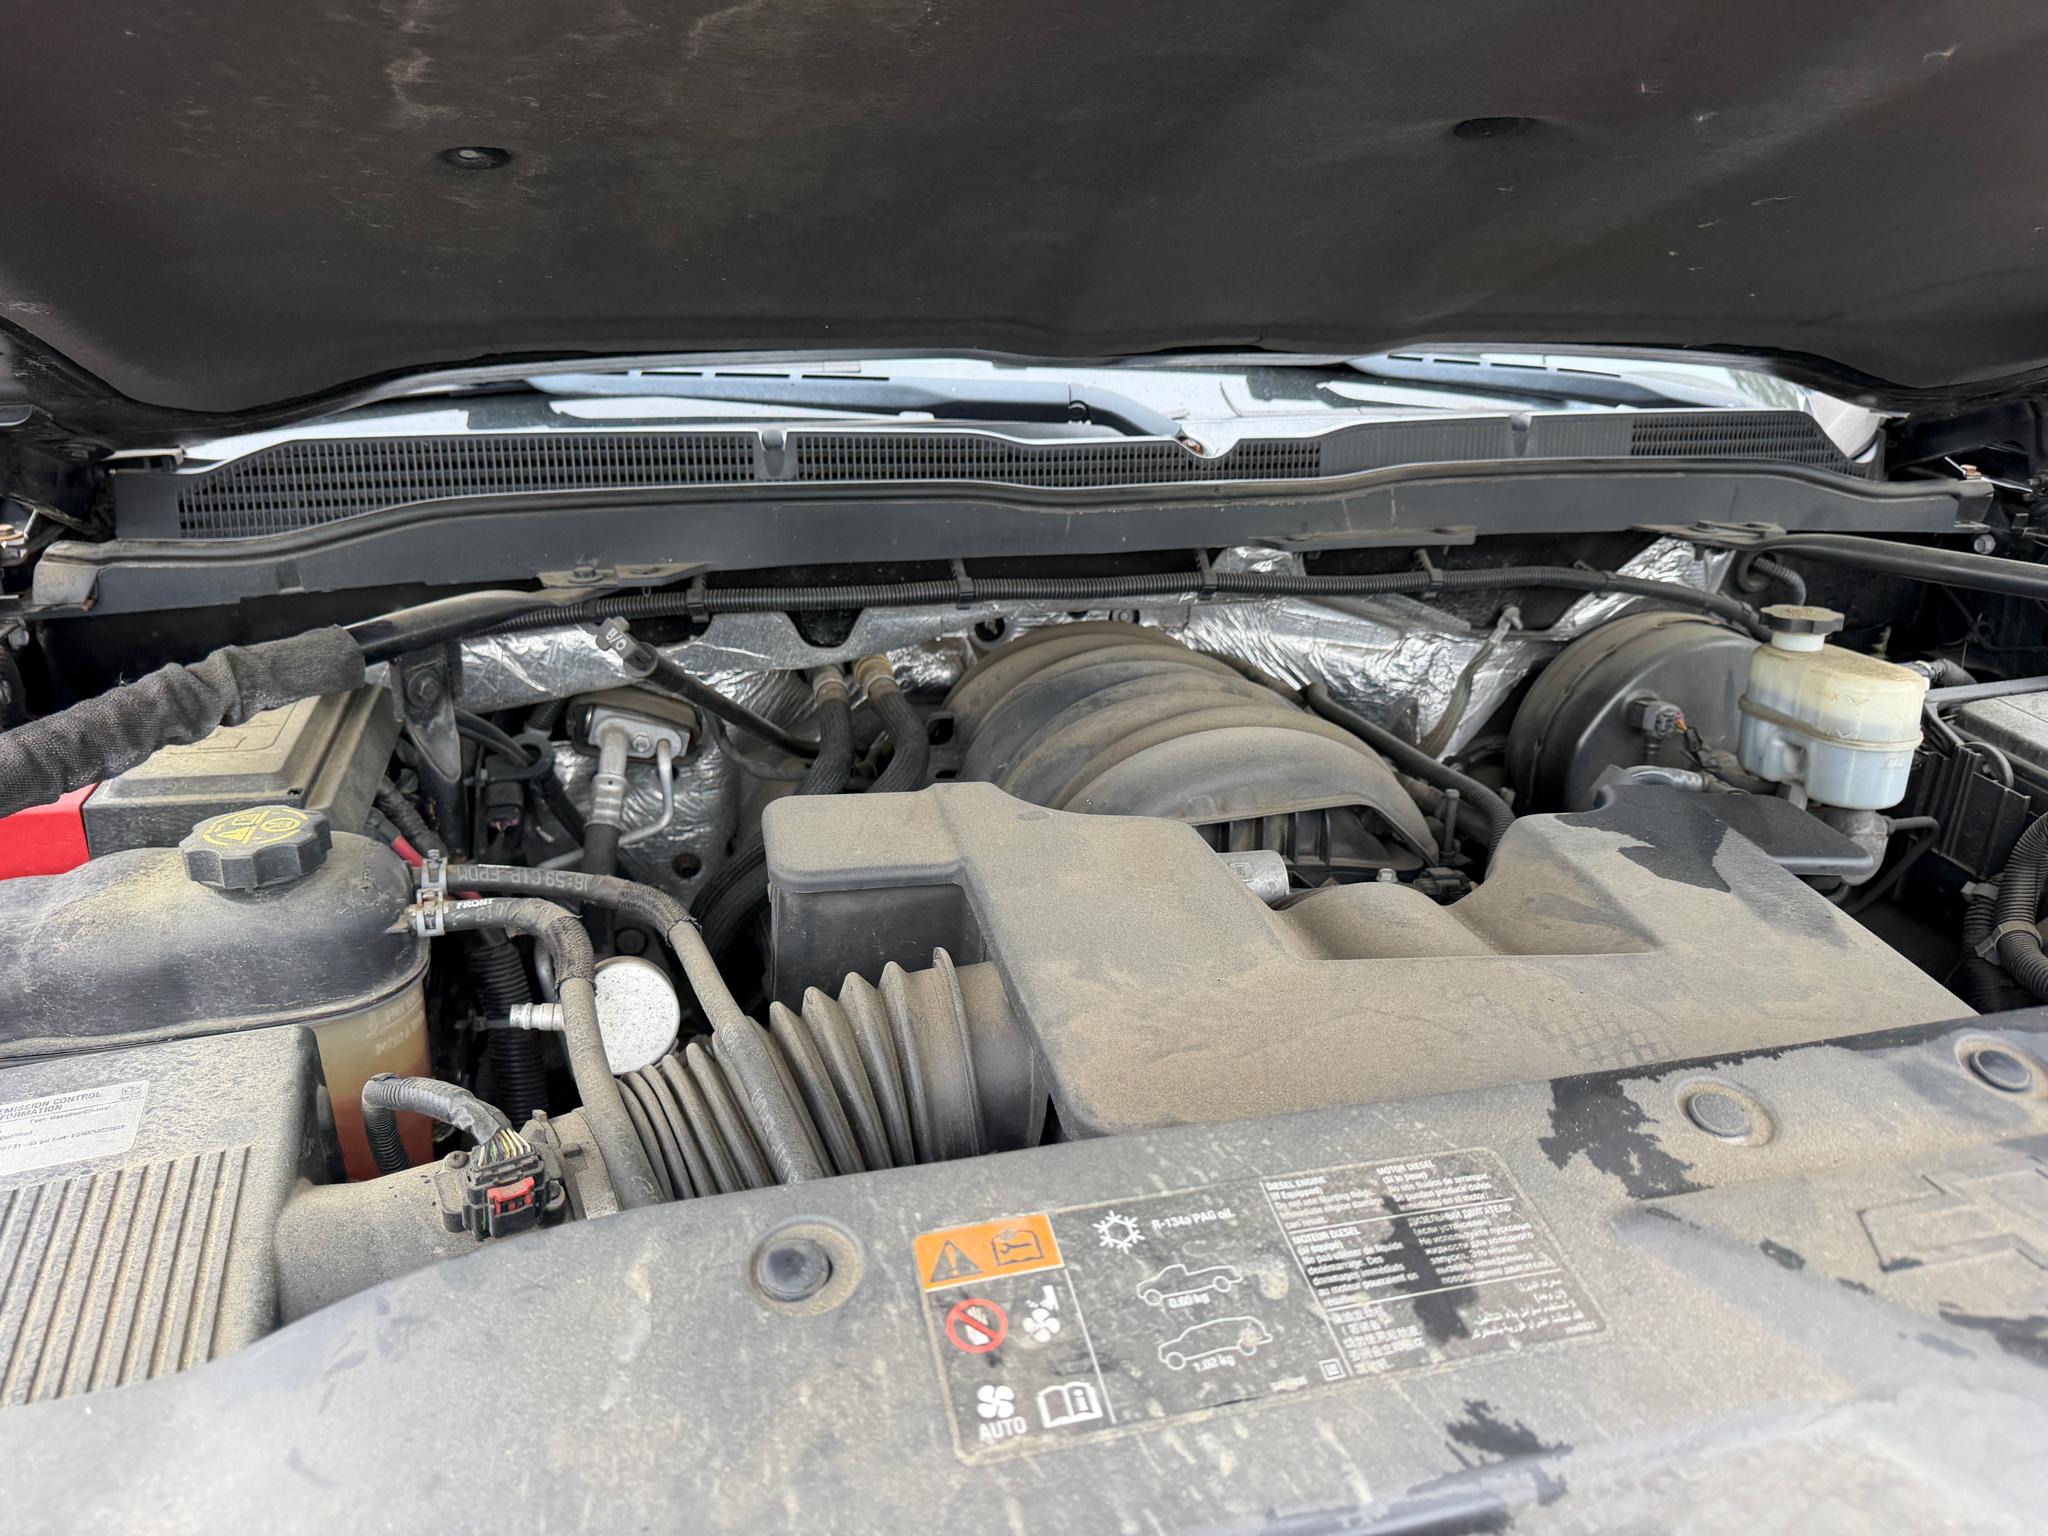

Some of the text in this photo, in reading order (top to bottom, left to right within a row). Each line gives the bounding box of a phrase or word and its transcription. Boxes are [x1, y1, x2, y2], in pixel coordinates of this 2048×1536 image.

[456, 898, 495, 910] FRONT
[53, 1091, 102, 1104] CONTROL
[1376, 1160, 1435, 1174] MOTOR DIESEL
[1266, 1175, 1326, 1190] DIESEL ENGINE
[1281, 1186, 1323, 1198] Equipped)
[1151, 1217, 1192, 1232] R-134a
[1192, 1210, 1217, 1224] PAG
[1292, 1227, 1361, 1243] MOTEUR DIESEL
[1217, 1355, 1236, 1368] kg
[978, 1416, 1027, 1441] AUTO
